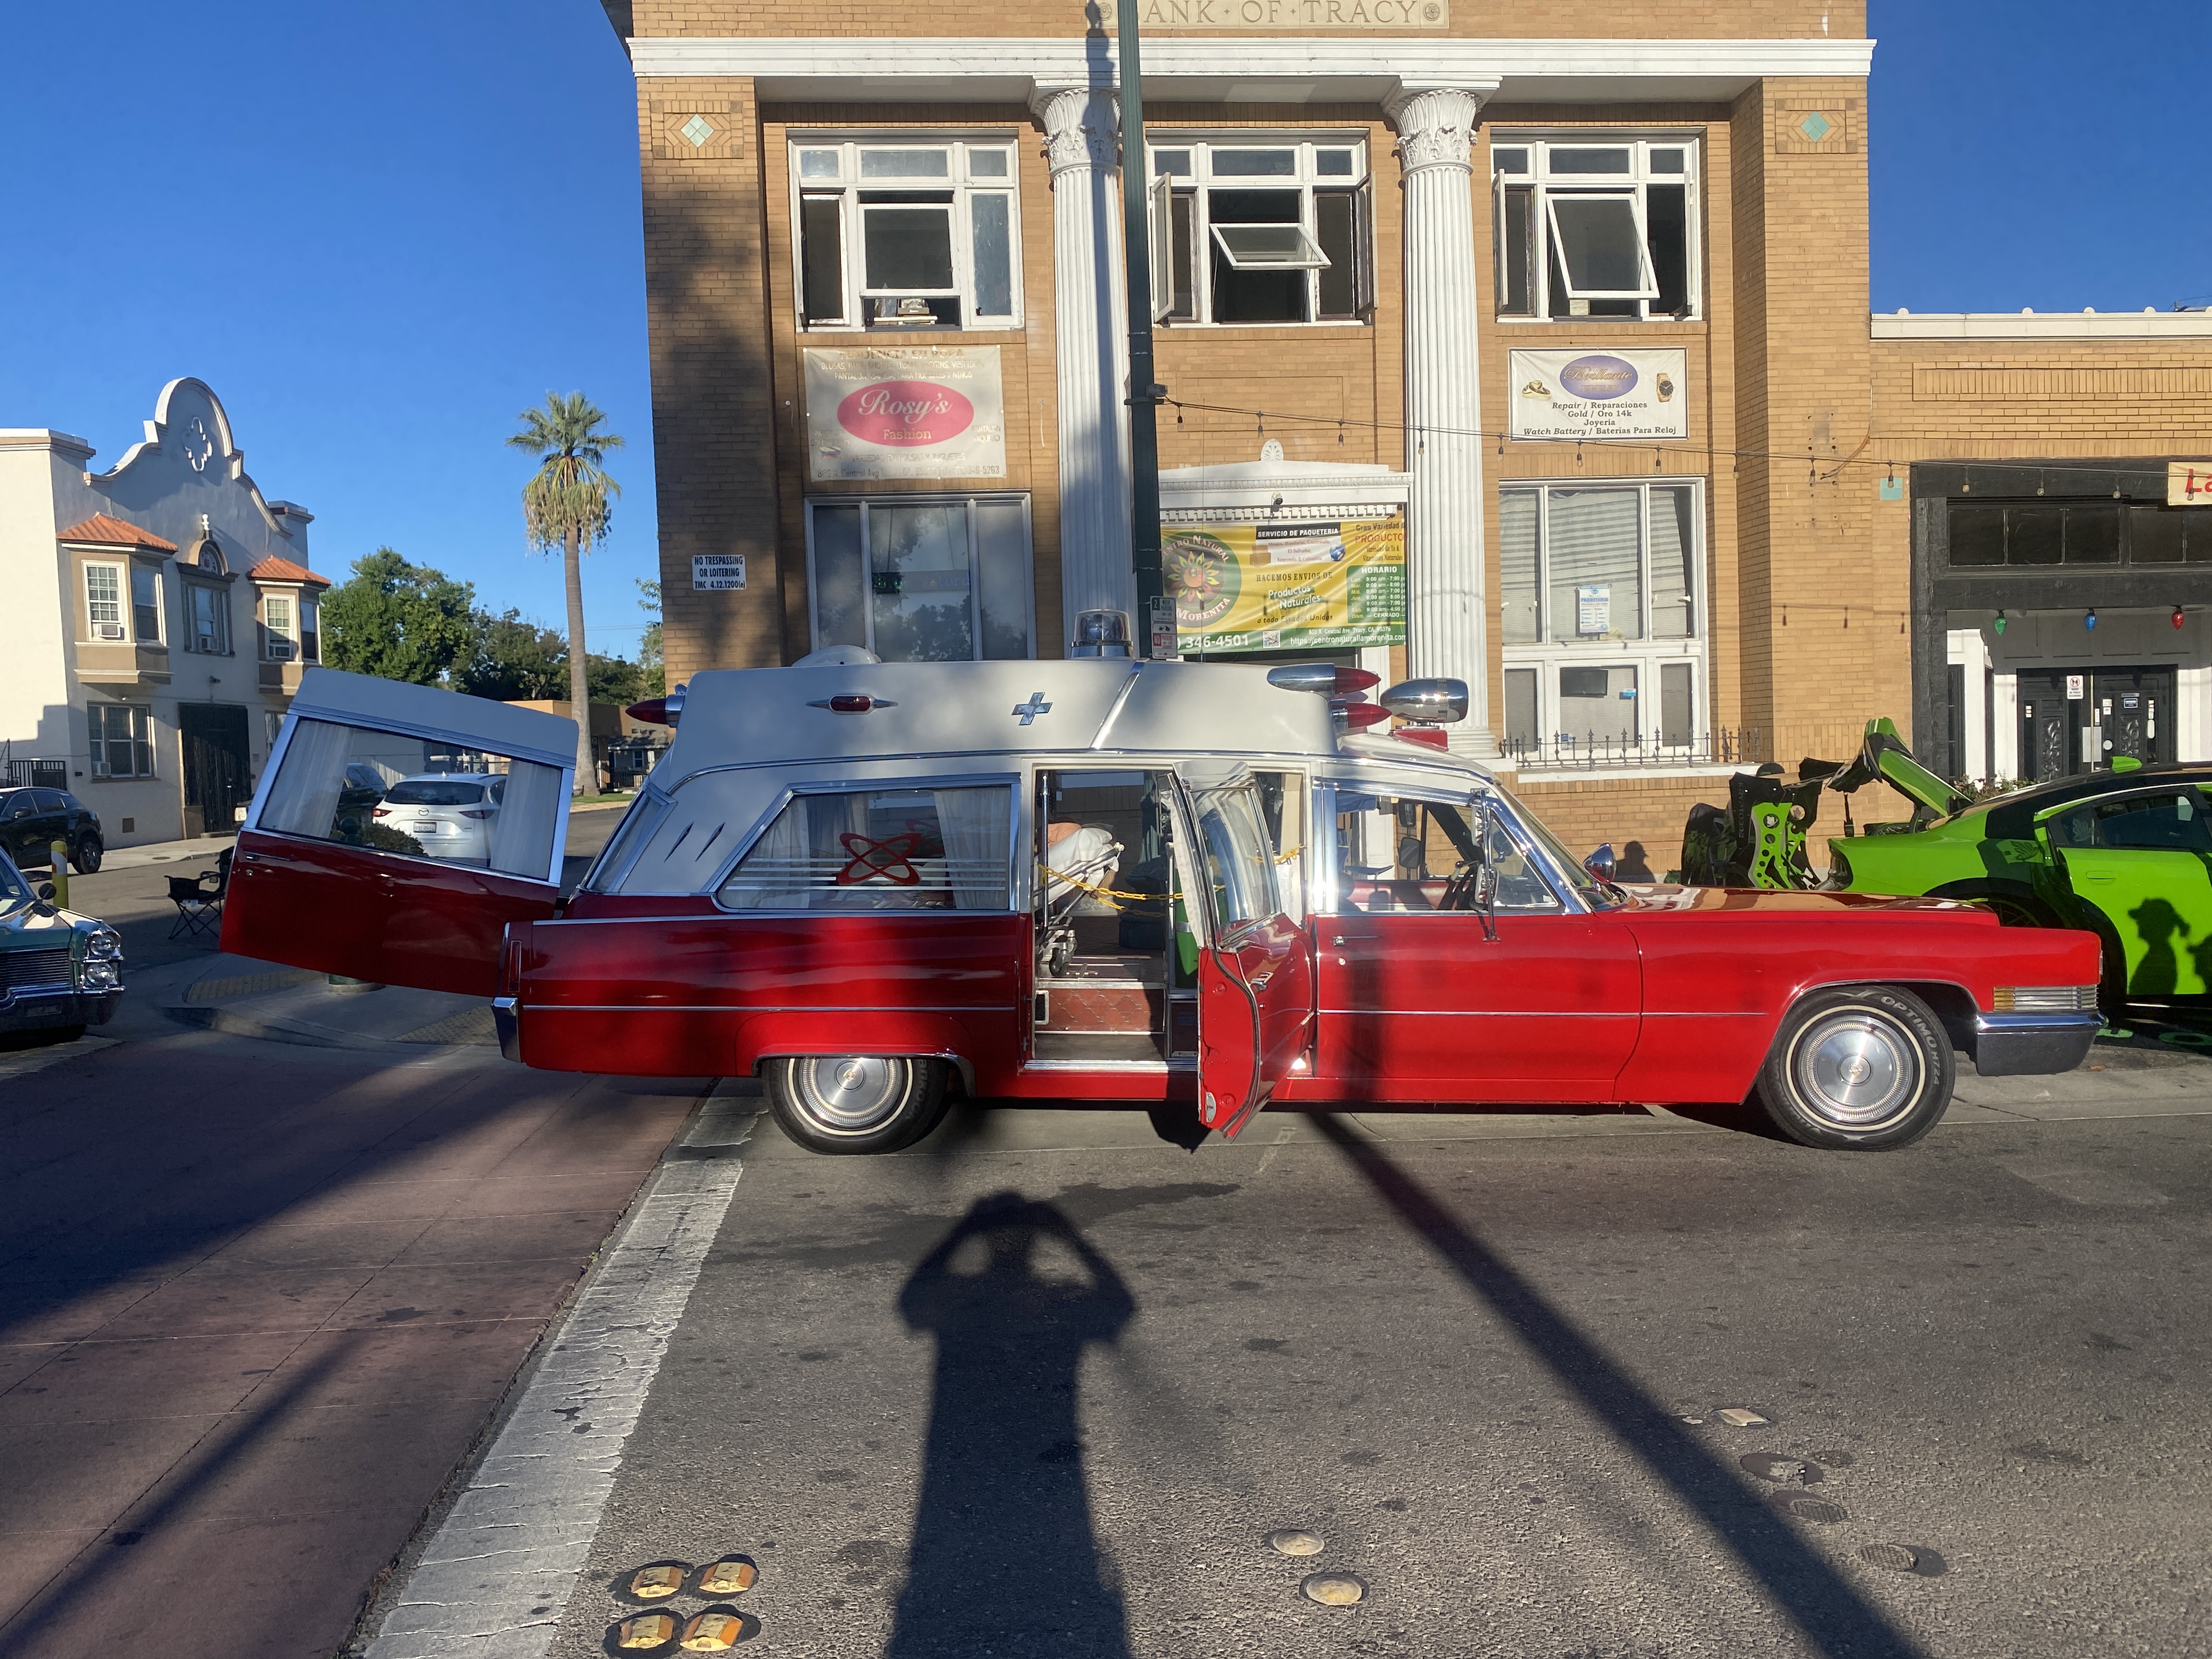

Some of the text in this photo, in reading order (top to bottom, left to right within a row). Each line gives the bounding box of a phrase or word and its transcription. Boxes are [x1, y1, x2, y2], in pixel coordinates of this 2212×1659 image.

[1143, 0, 1417, 24] ANK OF TRACY
[1564, 365, 1633, 381] Brillante
[858, 389, 953, 424] Rosy's
[1551, 402, 1581, 410] Repair
[1591, 402, 1647, 410] Reparaciones
[883, 428, 932, 439] Fashion
[1554, 427, 1587, 436] Battery
[1655, 426, 1677, 435] Reloj
[1355, 533, 1404, 543] PRODUCTO
[1193, 535, 1229, 563] NATURAL
[695, 556, 743, 565] NO TRESPASSING
[699, 568, 740, 577] OR LOITERING
[710, 580, 745, 589] 4.12.1200(e)
[1268, 585, 1311, 599] Productos
[1154, 599, 1158, 608] 2
[1177, 597, 1231, 620] MORENITA
[1280, 595, 1321, 609] Naturales
[1154, 635, 1160, 644] NO
[1186, 635, 1249, 648] 346-4501
[1881, 996, 1940, 1085] OPTIMO H724
[905, 1059, 928, 1120] ankook
